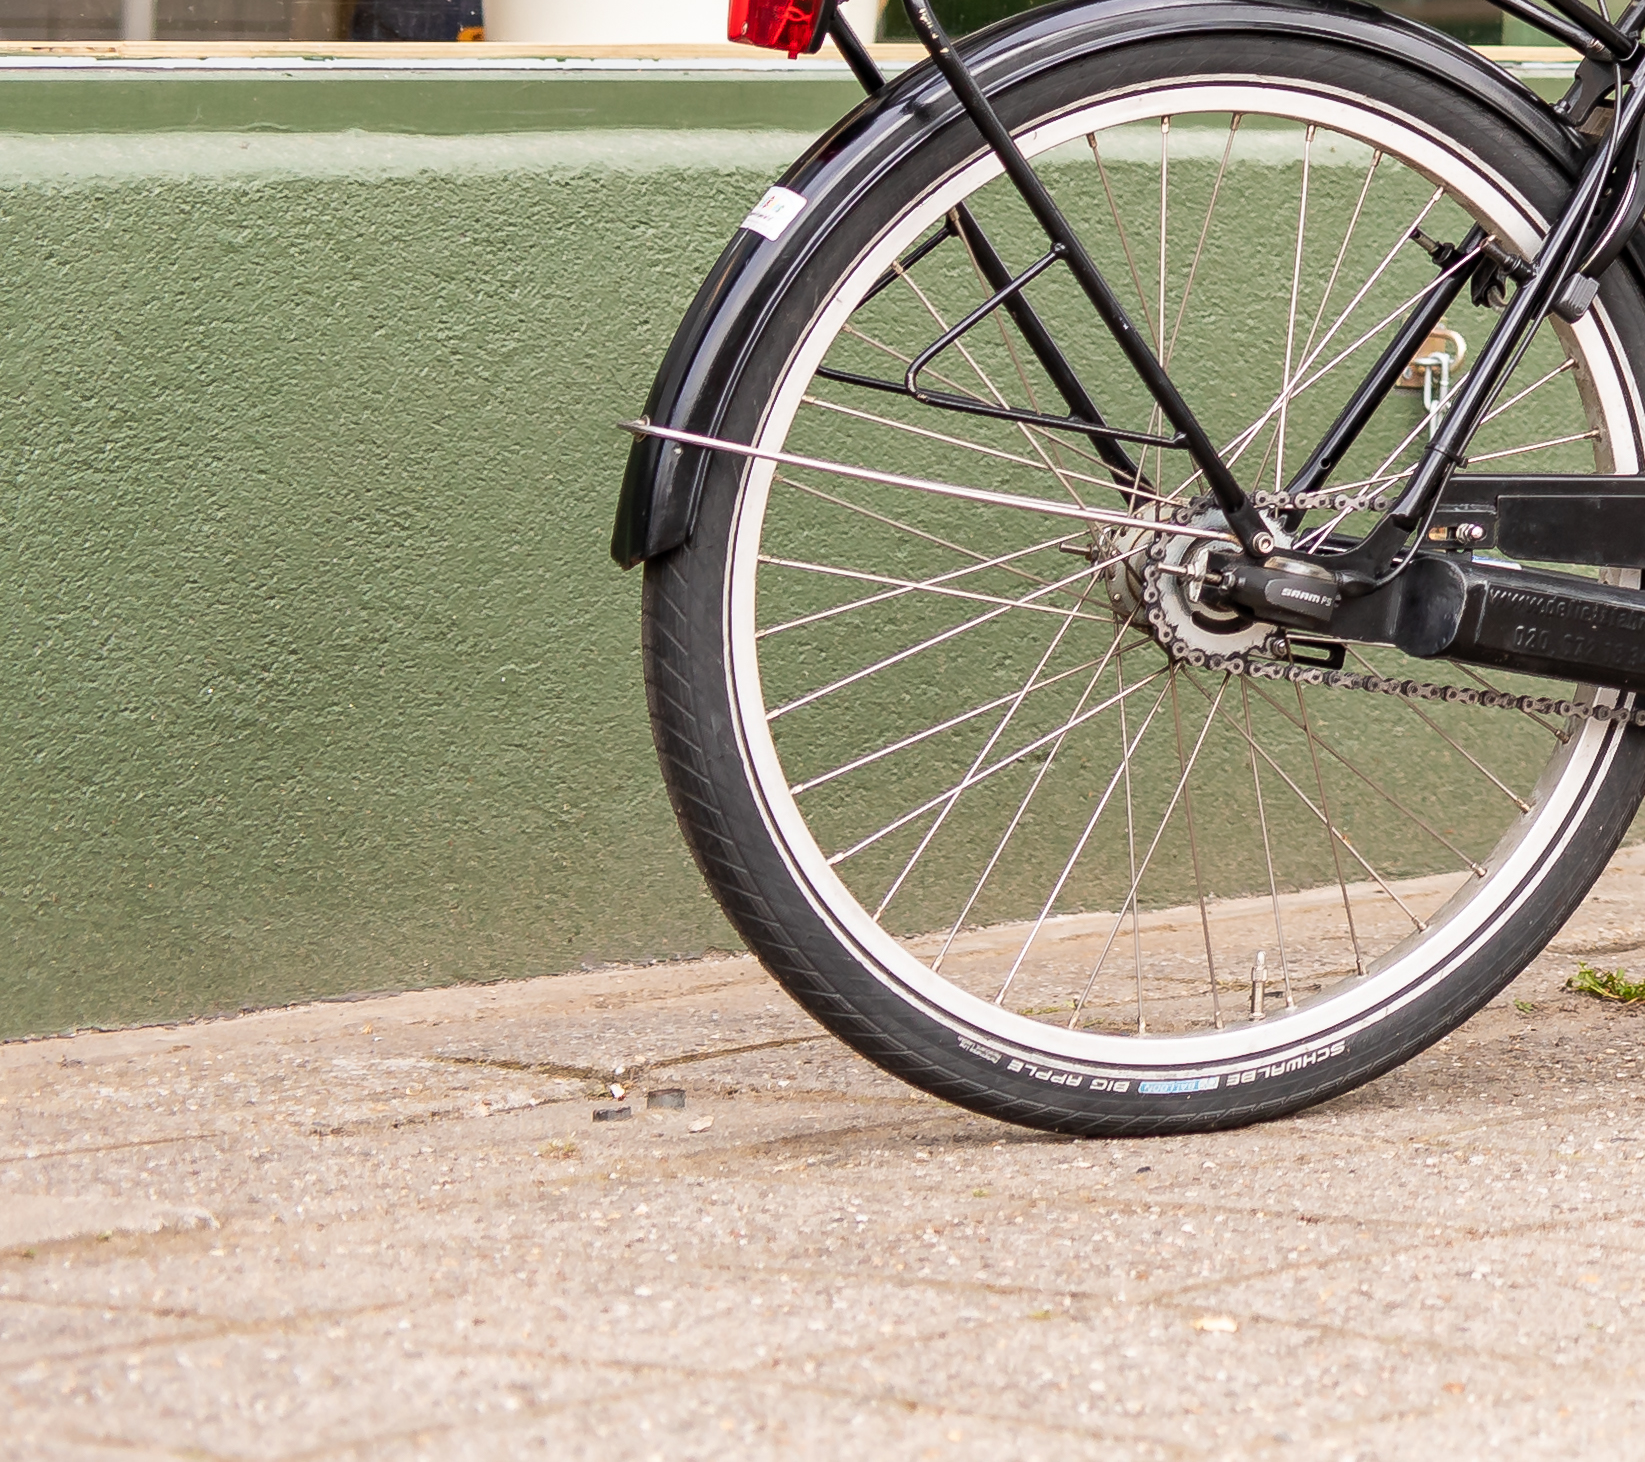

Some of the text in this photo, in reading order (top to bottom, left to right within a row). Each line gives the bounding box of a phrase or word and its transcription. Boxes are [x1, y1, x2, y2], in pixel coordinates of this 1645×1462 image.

[1006, 1059, 1082, 1088] APPLE
[1226, 1039, 1346, 1088] SCHWALBE
[1089, 1077, 1132, 1094] BIG
